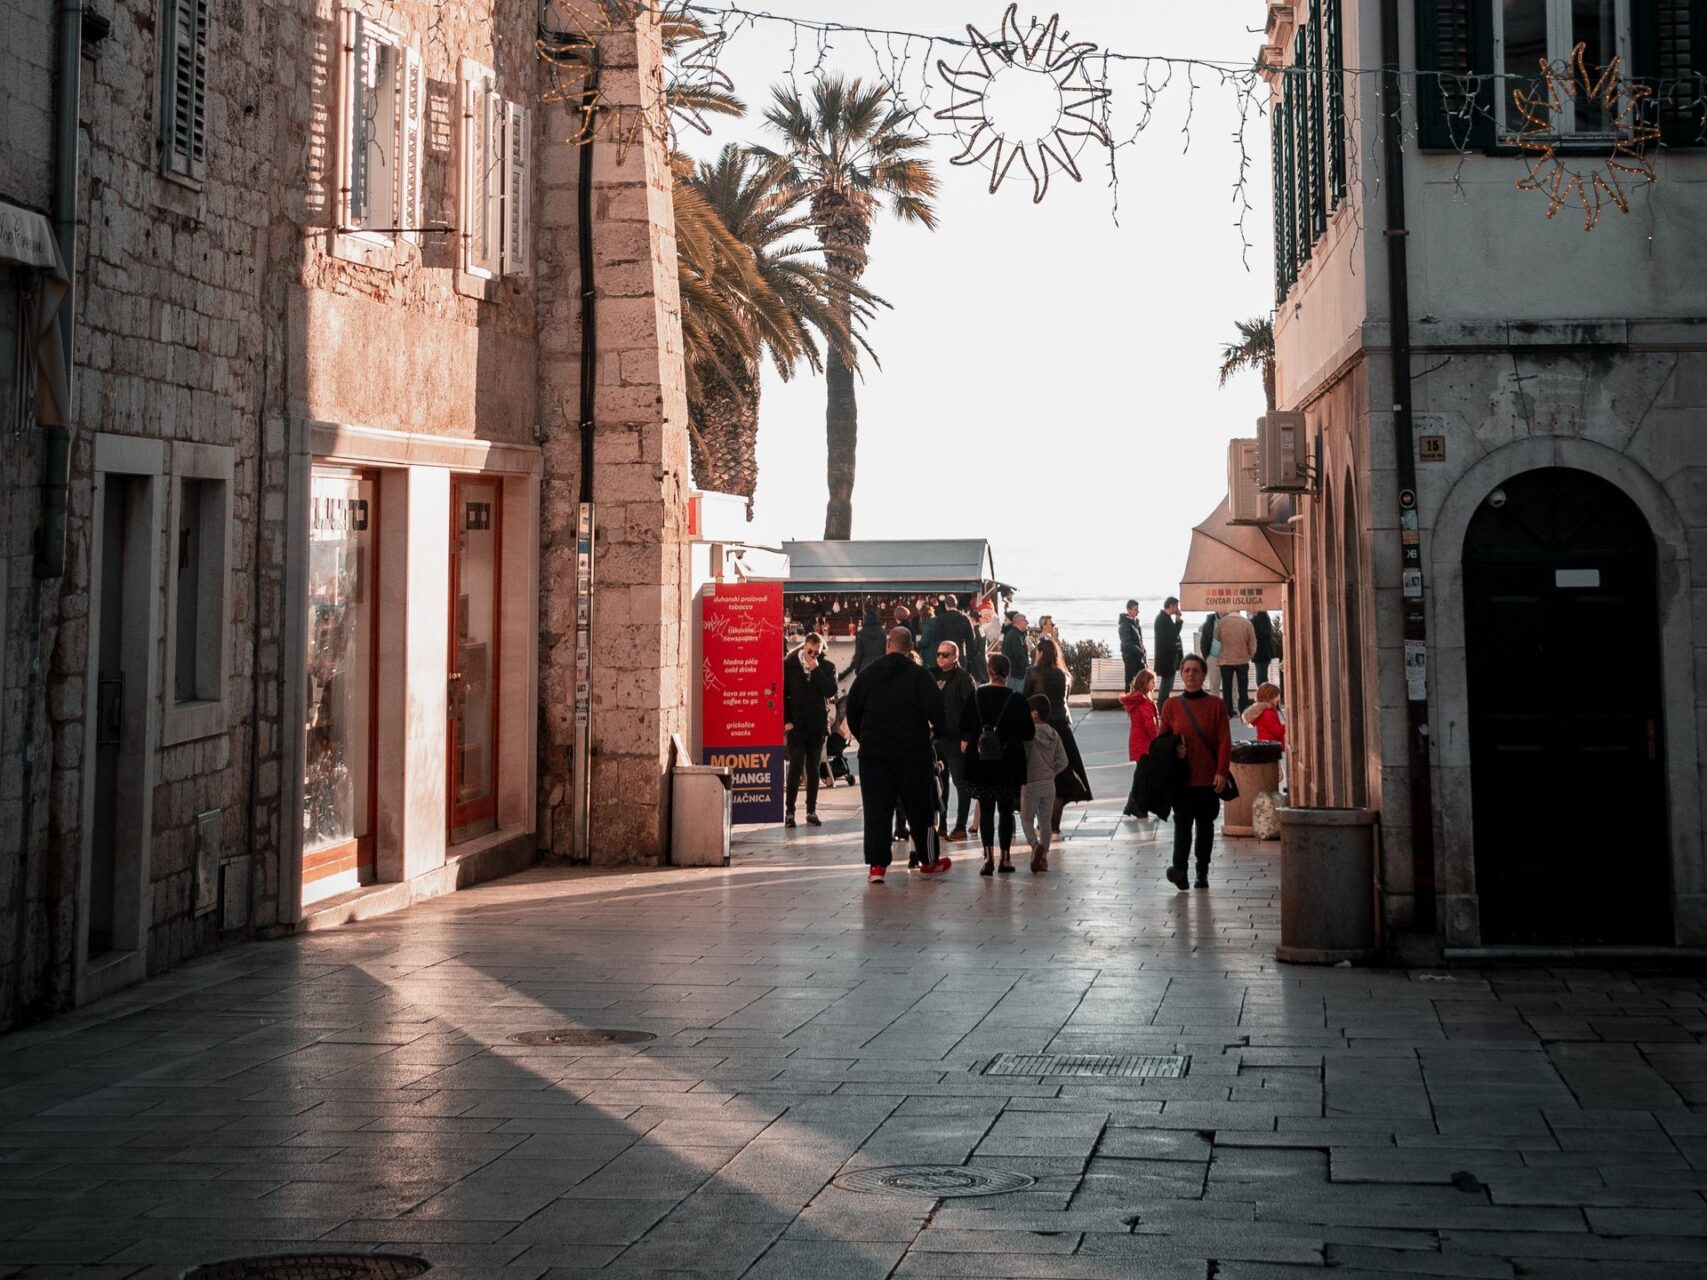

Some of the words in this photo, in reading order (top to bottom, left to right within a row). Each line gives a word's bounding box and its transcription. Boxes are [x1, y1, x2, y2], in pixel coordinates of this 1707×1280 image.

[1427, 440, 1439, 452] 15
[713, 595, 740, 603] duhanski
[740, 595, 768, 604] proizvodi
[1206, 597, 1232, 605] CENTAR
[1232, 597, 1263, 605] USLUGA
[723, 698, 741, 706] coffee
[726, 721, 755, 730] grickalice
[710, 753, 771, 769] MONEY
[731, 773, 771, 784] HANGE
[732, 793, 771, 804] JAČNICA
